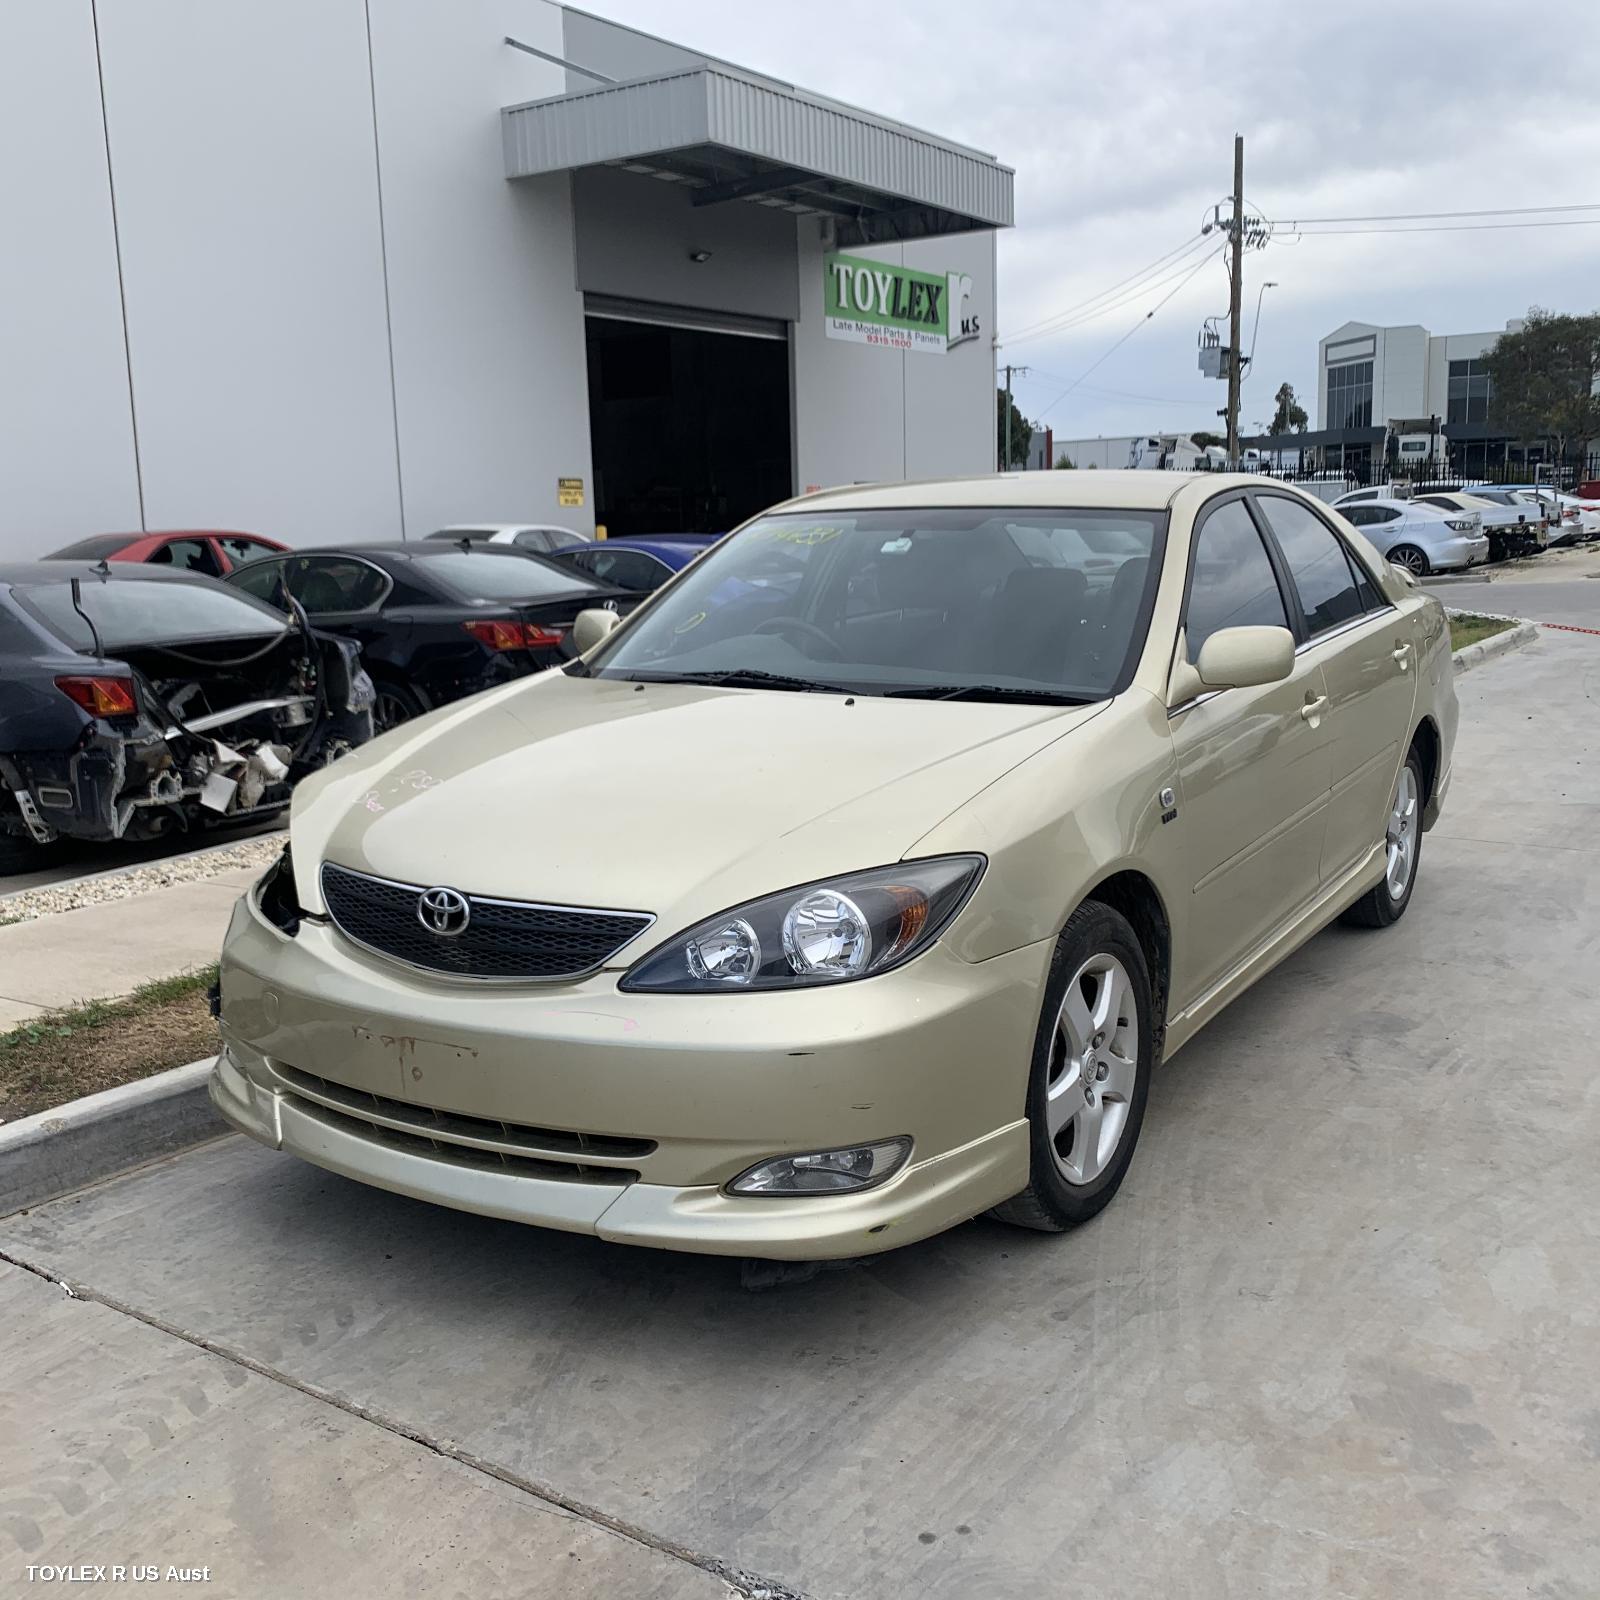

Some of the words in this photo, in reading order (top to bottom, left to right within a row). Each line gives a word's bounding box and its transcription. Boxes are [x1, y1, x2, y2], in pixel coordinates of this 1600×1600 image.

[833, 263, 943, 326] TOYLEX
[833, 319, 853, 333] Late
[855, 322, 882, 337] Model
[884, 327, 905, 341] Parts
[915, 333, 941, 346] Panels
